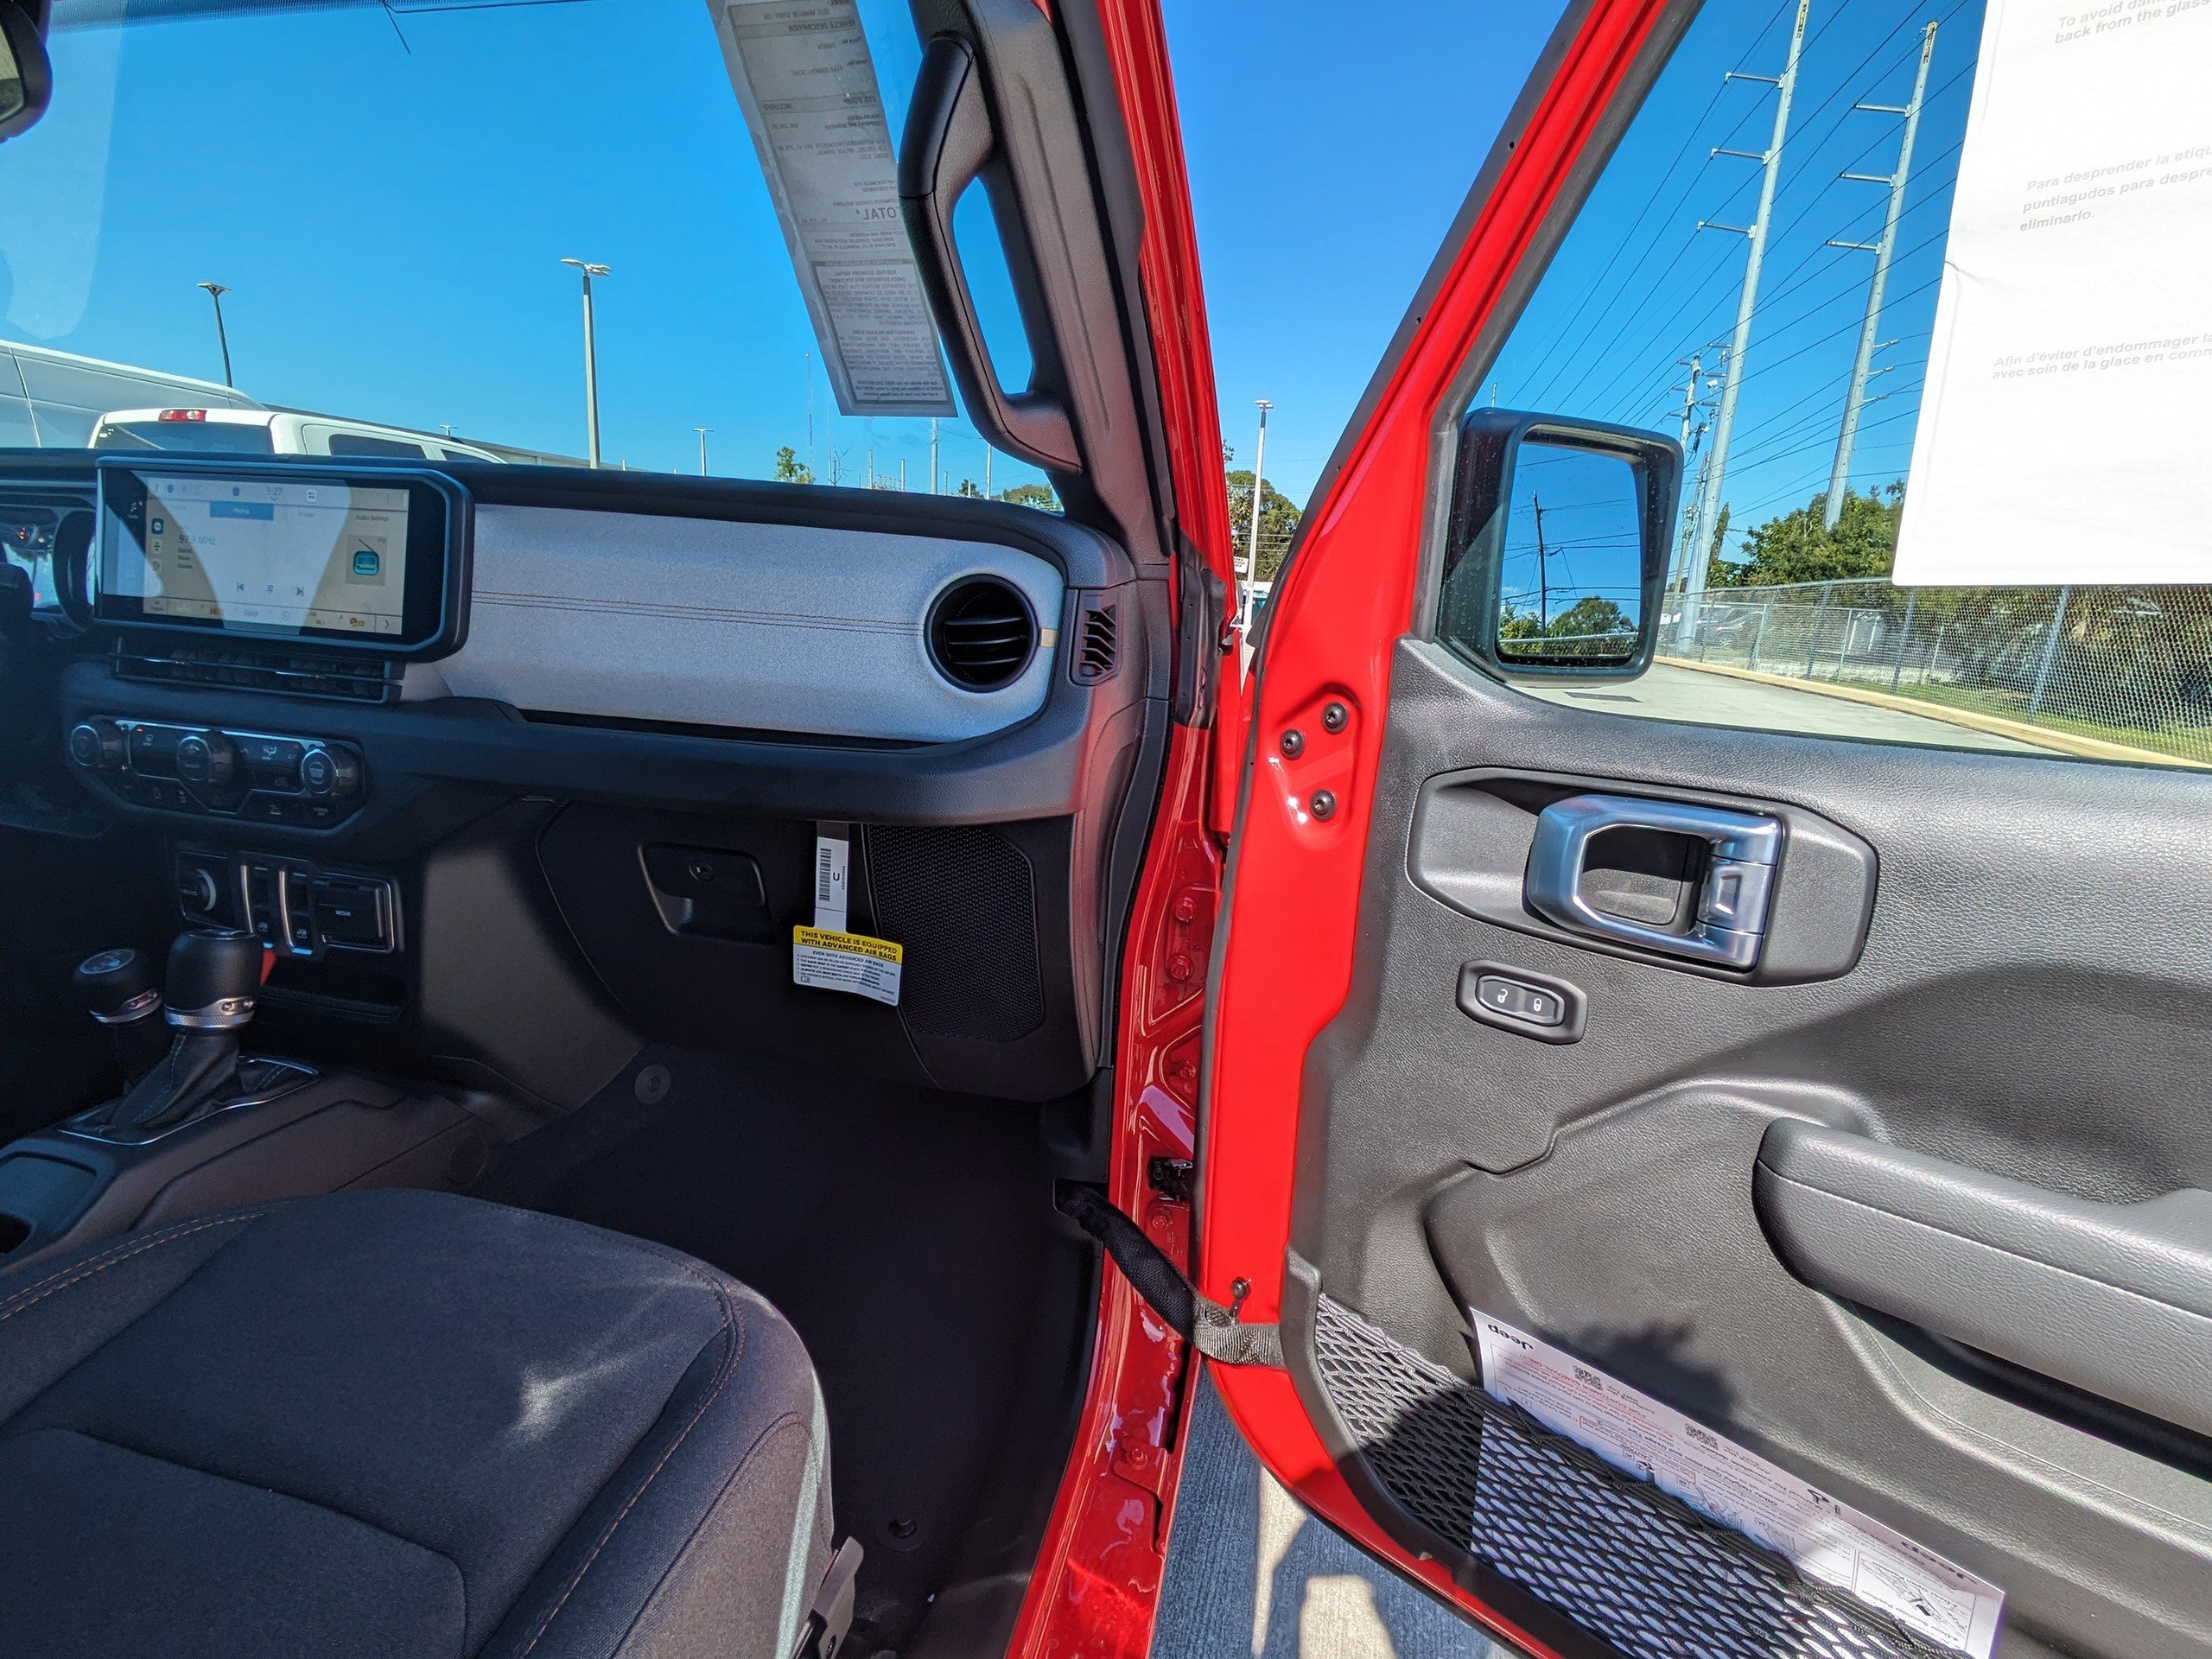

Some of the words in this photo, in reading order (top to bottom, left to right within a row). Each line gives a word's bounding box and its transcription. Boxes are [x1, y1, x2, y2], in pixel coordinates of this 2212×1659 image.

[2054, 26, 2091, 44] back
[2095, 16, 2132, 33] from
[2136, 8, 2162, 22] the
[2059, 16, 2075, 29] To
[2080, 3, 2123, 22] avoid
[2026, 178, 2059, 192] Para
[2063, 157, 2152, 185] desprender
[2156, 154, 2170, 166] la
[2023, 187, 2115, 214] puntiagudos
[2119, 177, 2154, 196] para
[2019, 210, 2095, 232] eliminarlo.
[1994, 356, 2022, 367] Afin
[2082, 334, 2199, 357] d'endommager
[1993, 368, 2024, 379] avec
[2028, 364, 2057, 376] soin
[2063, 361, 2079, 372] de
[2083, 359, 2095, 370] la
[2100, 354, 2139, 370] glace
[2145, 353, 2164, 364] en
[832, 872, 840, 881] U
[819, 933, 851, 944] VEHICLE
[862, 940, 898, 954] EQUIPPED
[822, 940, 863, 953] ADVANCED
[878, 950, 897, 961] BAGS
[1487, 1323, 1534, 1351] Jeep
